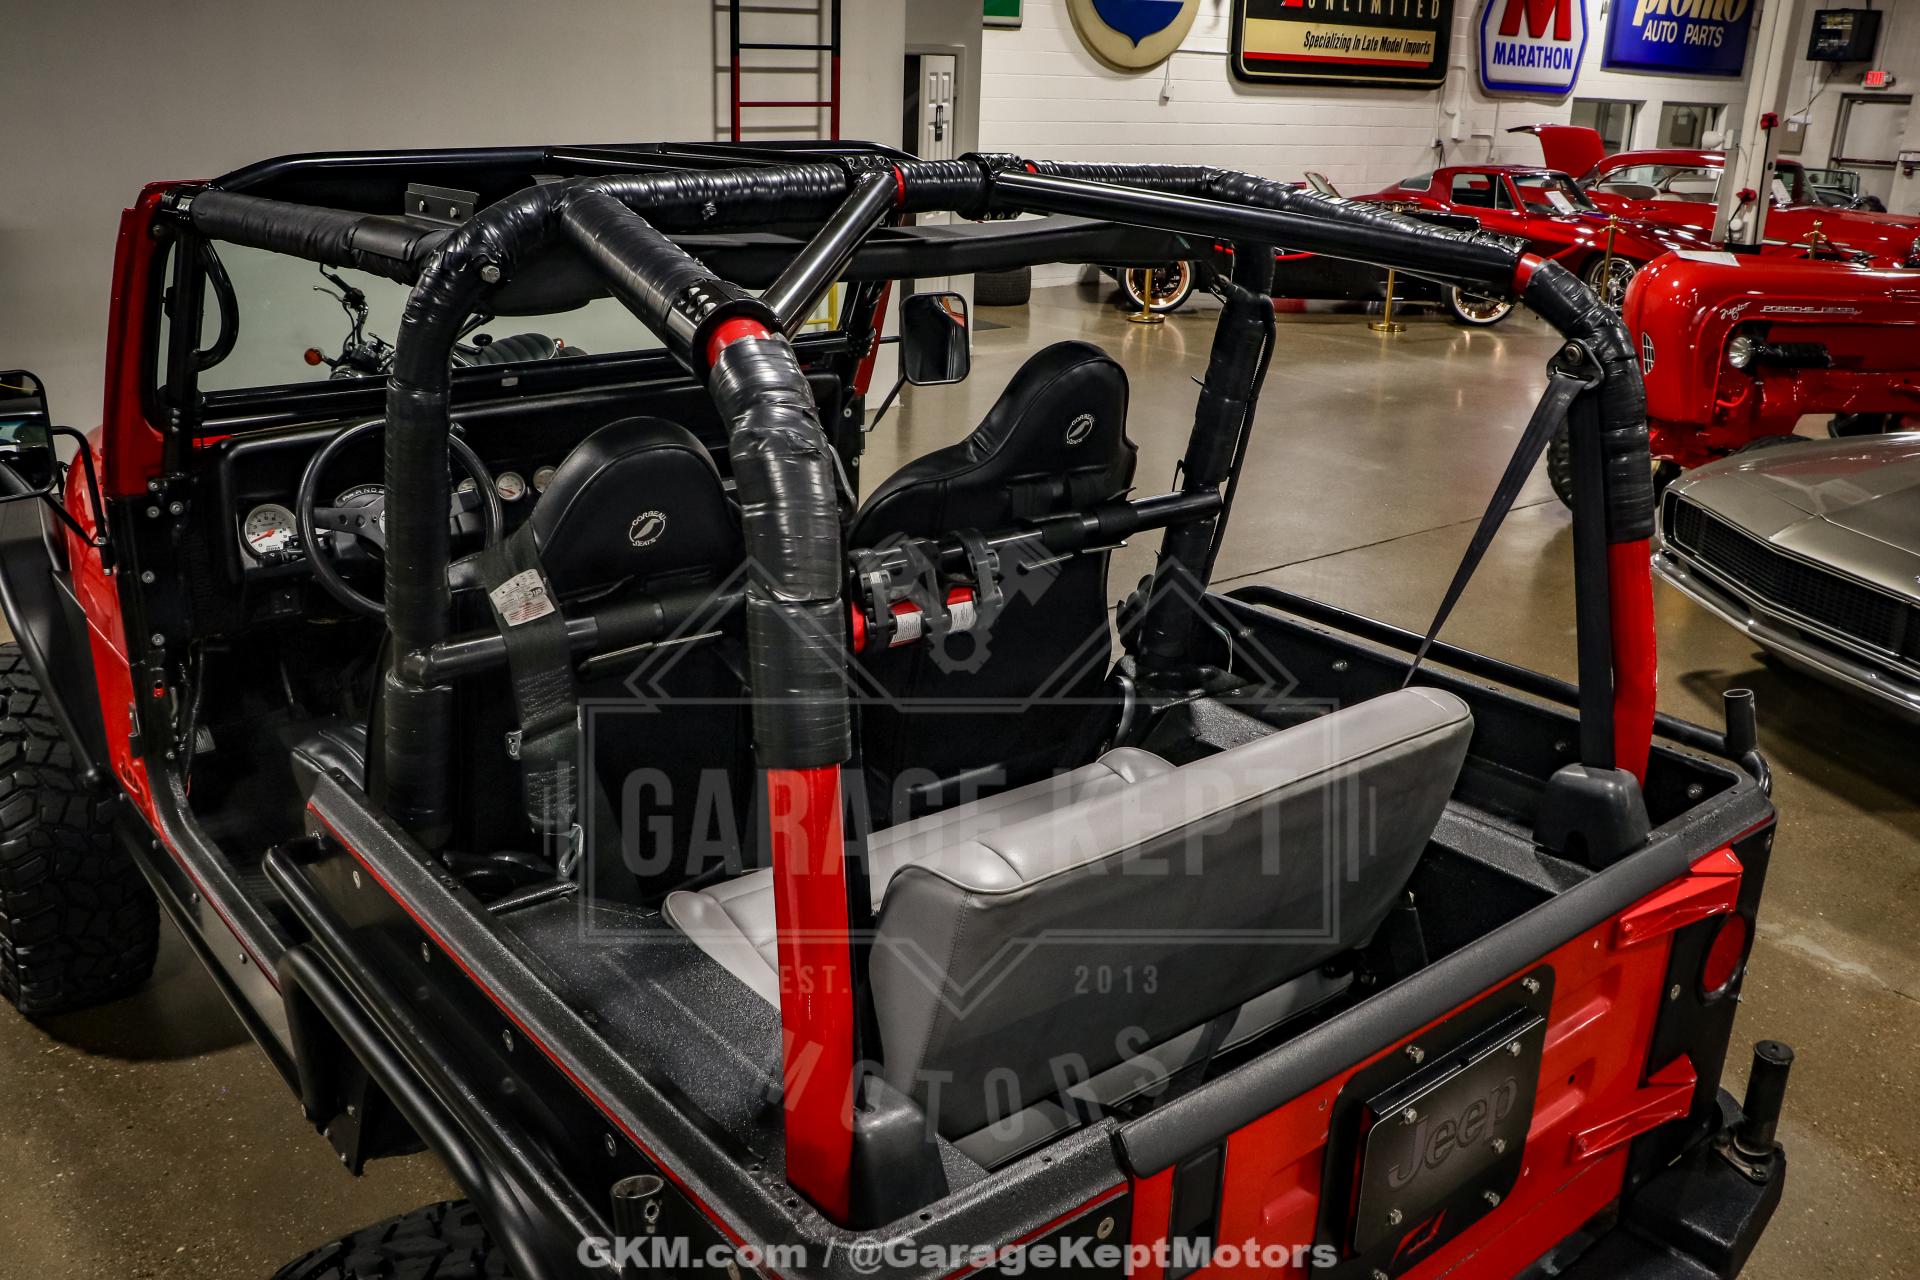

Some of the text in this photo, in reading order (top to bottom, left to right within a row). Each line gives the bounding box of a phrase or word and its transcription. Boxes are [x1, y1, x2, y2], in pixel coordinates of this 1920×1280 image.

[1303, 30, 1432, 56] Specializing In Late Model Imports
[1642, 19, 1724, 47] AUTO PARTS
[1493, 41, 1573, 70] MARATHON
[1761, 305, 1815, 313] PORSCHE
[632, 511, 667, 525] CORBEAU
[1388, 1076, 1518, 1190] Jeep
